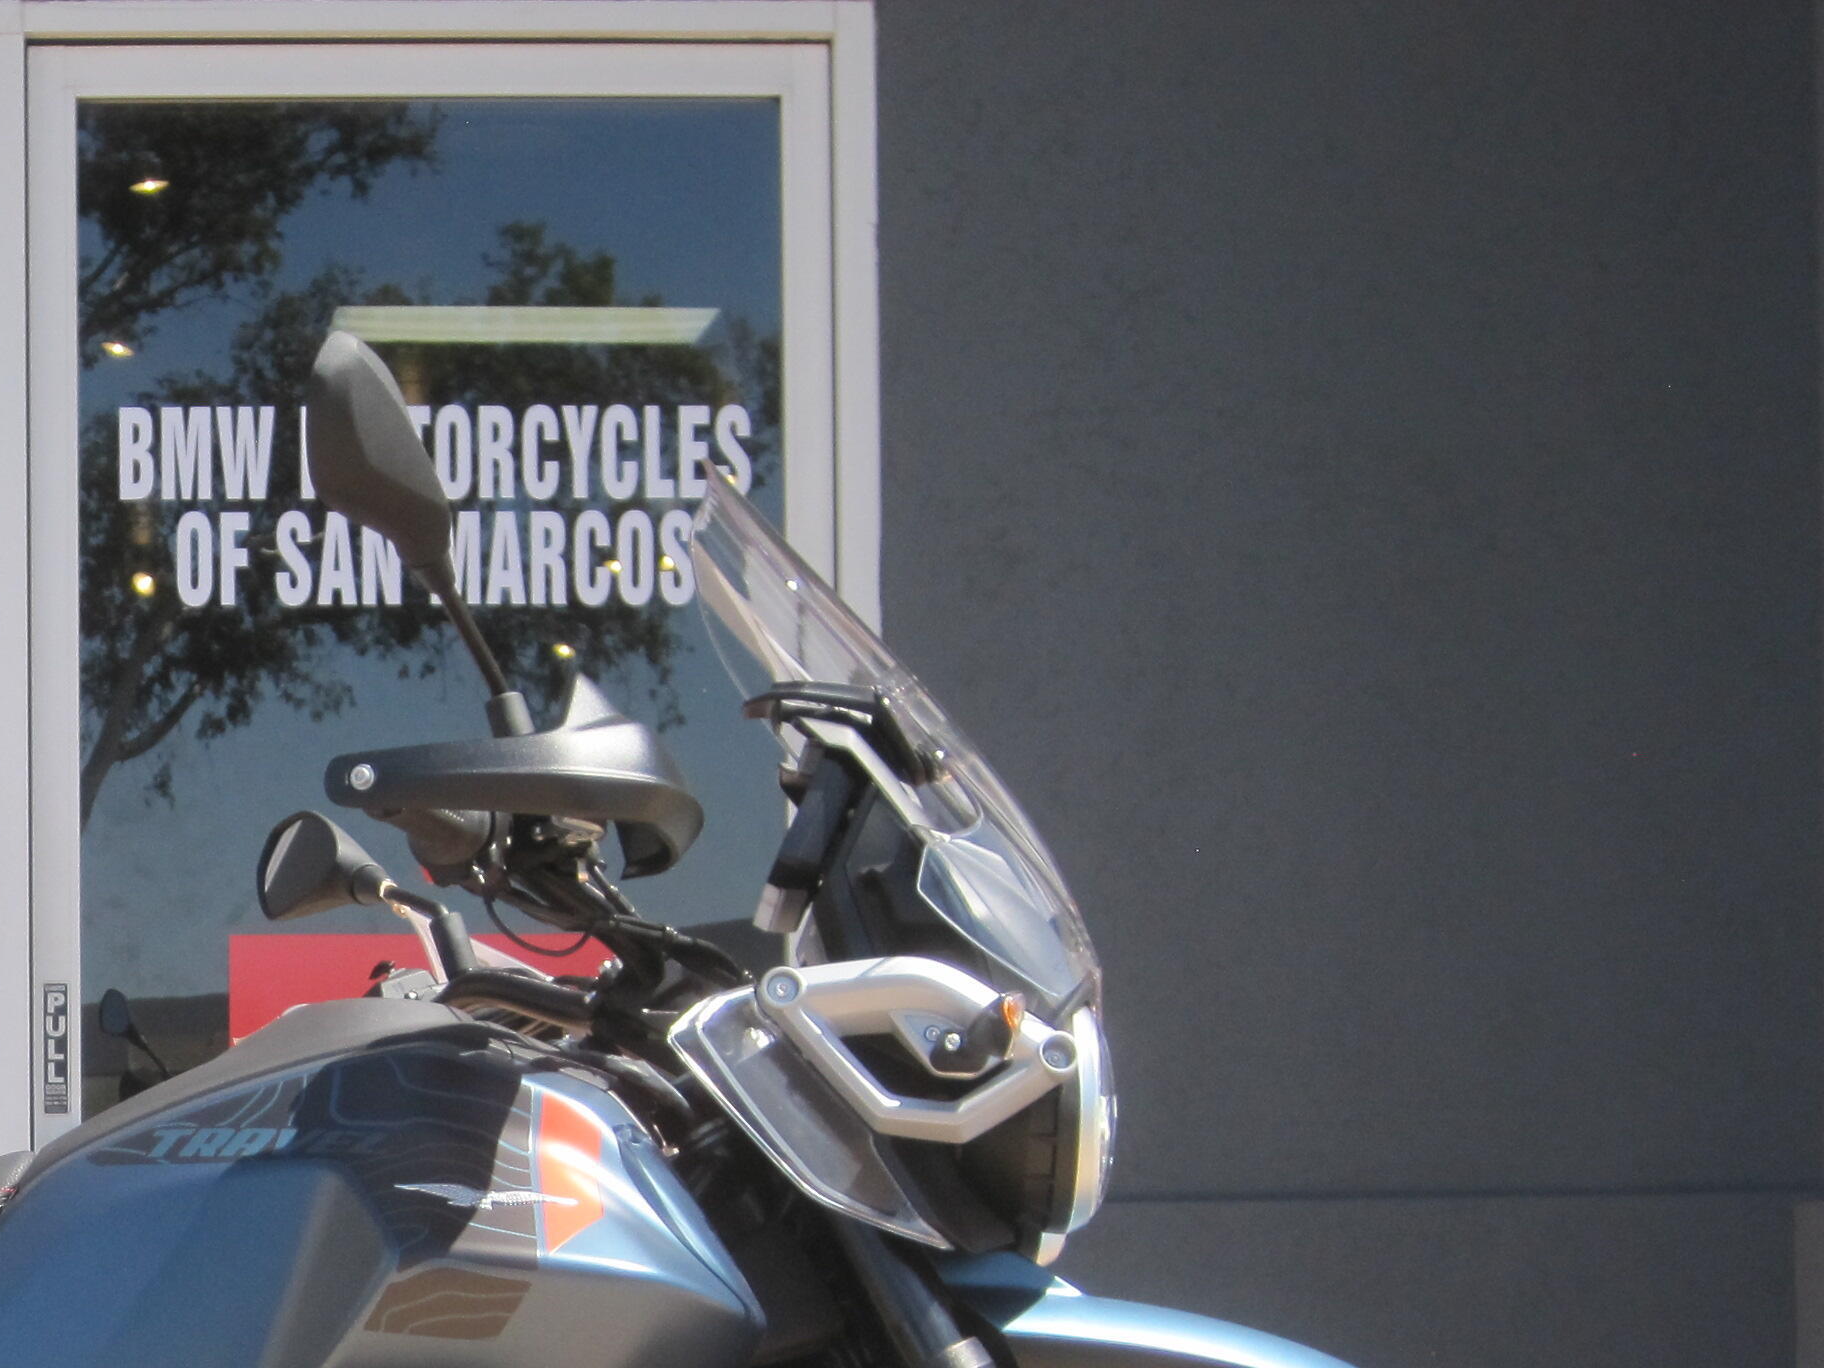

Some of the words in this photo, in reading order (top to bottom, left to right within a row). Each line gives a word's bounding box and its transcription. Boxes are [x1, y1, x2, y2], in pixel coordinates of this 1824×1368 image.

[118, 406, 275, 500] BMW
[300, 403, 752, 500] ORCYCLES
[176, 510, 250, 606] OF
[275, 510, 402, 607] SAN
[429, 509, 697, 607] MARCOS
[45, 991, 67, 1083] PULL
